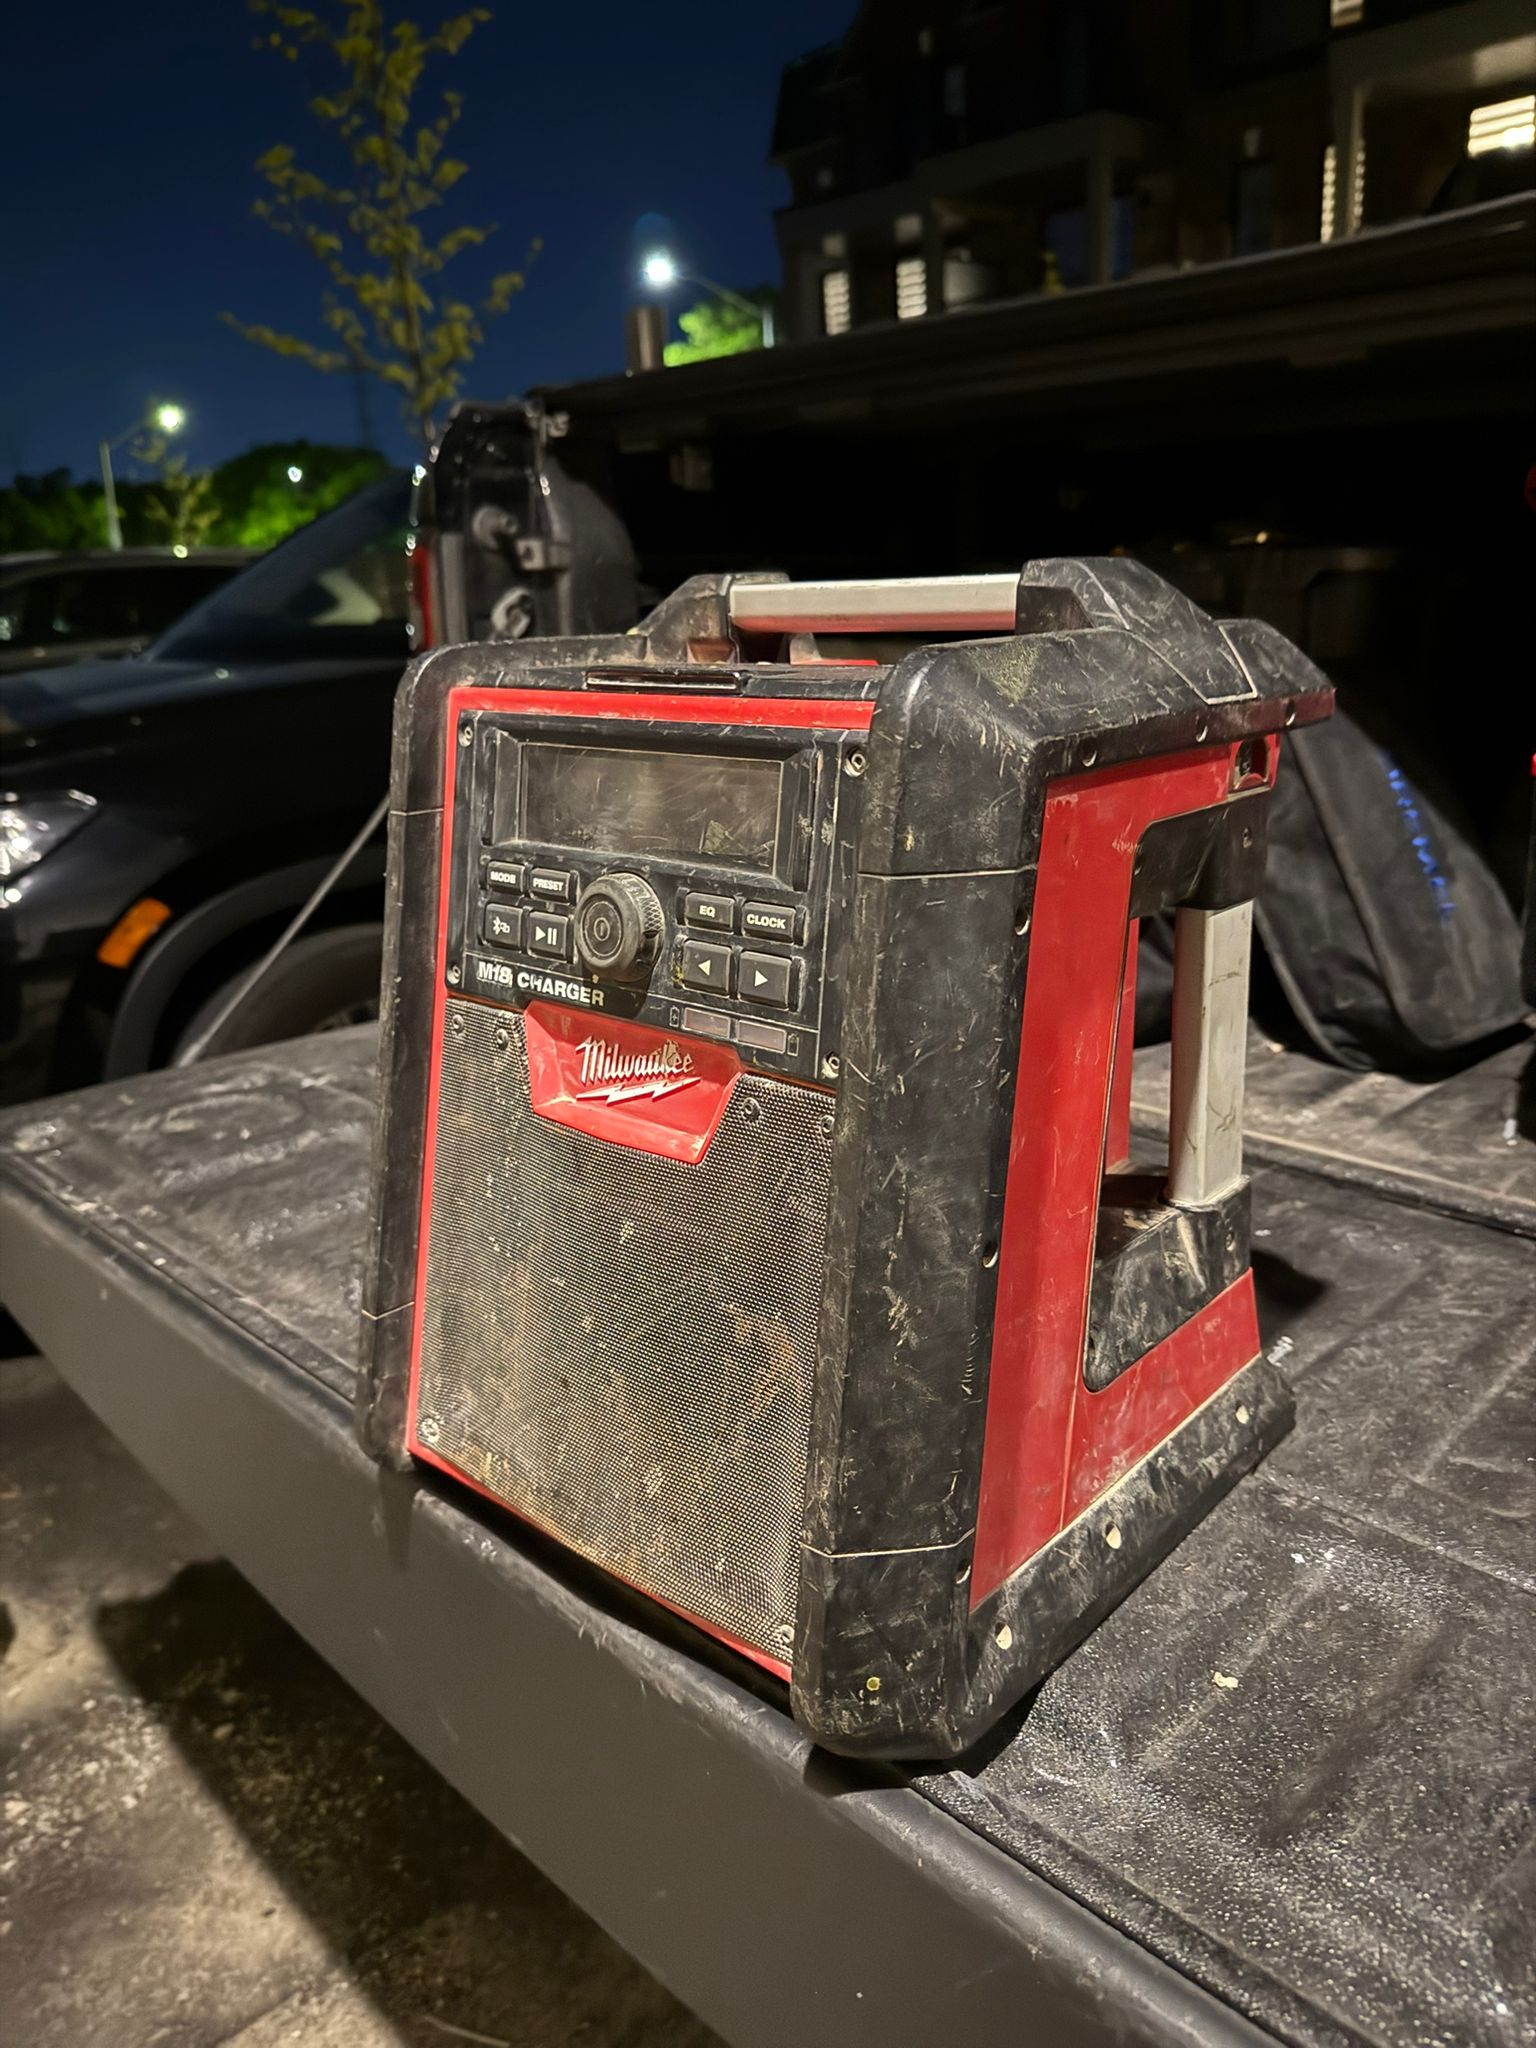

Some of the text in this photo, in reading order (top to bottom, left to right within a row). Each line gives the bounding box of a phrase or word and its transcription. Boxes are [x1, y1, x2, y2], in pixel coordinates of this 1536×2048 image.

[490, 871, 516, 884] MODE
[533, 877, 564, 892] PRESET
[699, 905, 716, 918] EQ
[746, 913, 786, 930] CLOCK
[478, 961, 605, 1007] M18 CHARGER
[575, 1036, 694, 1085] Milwaukee
